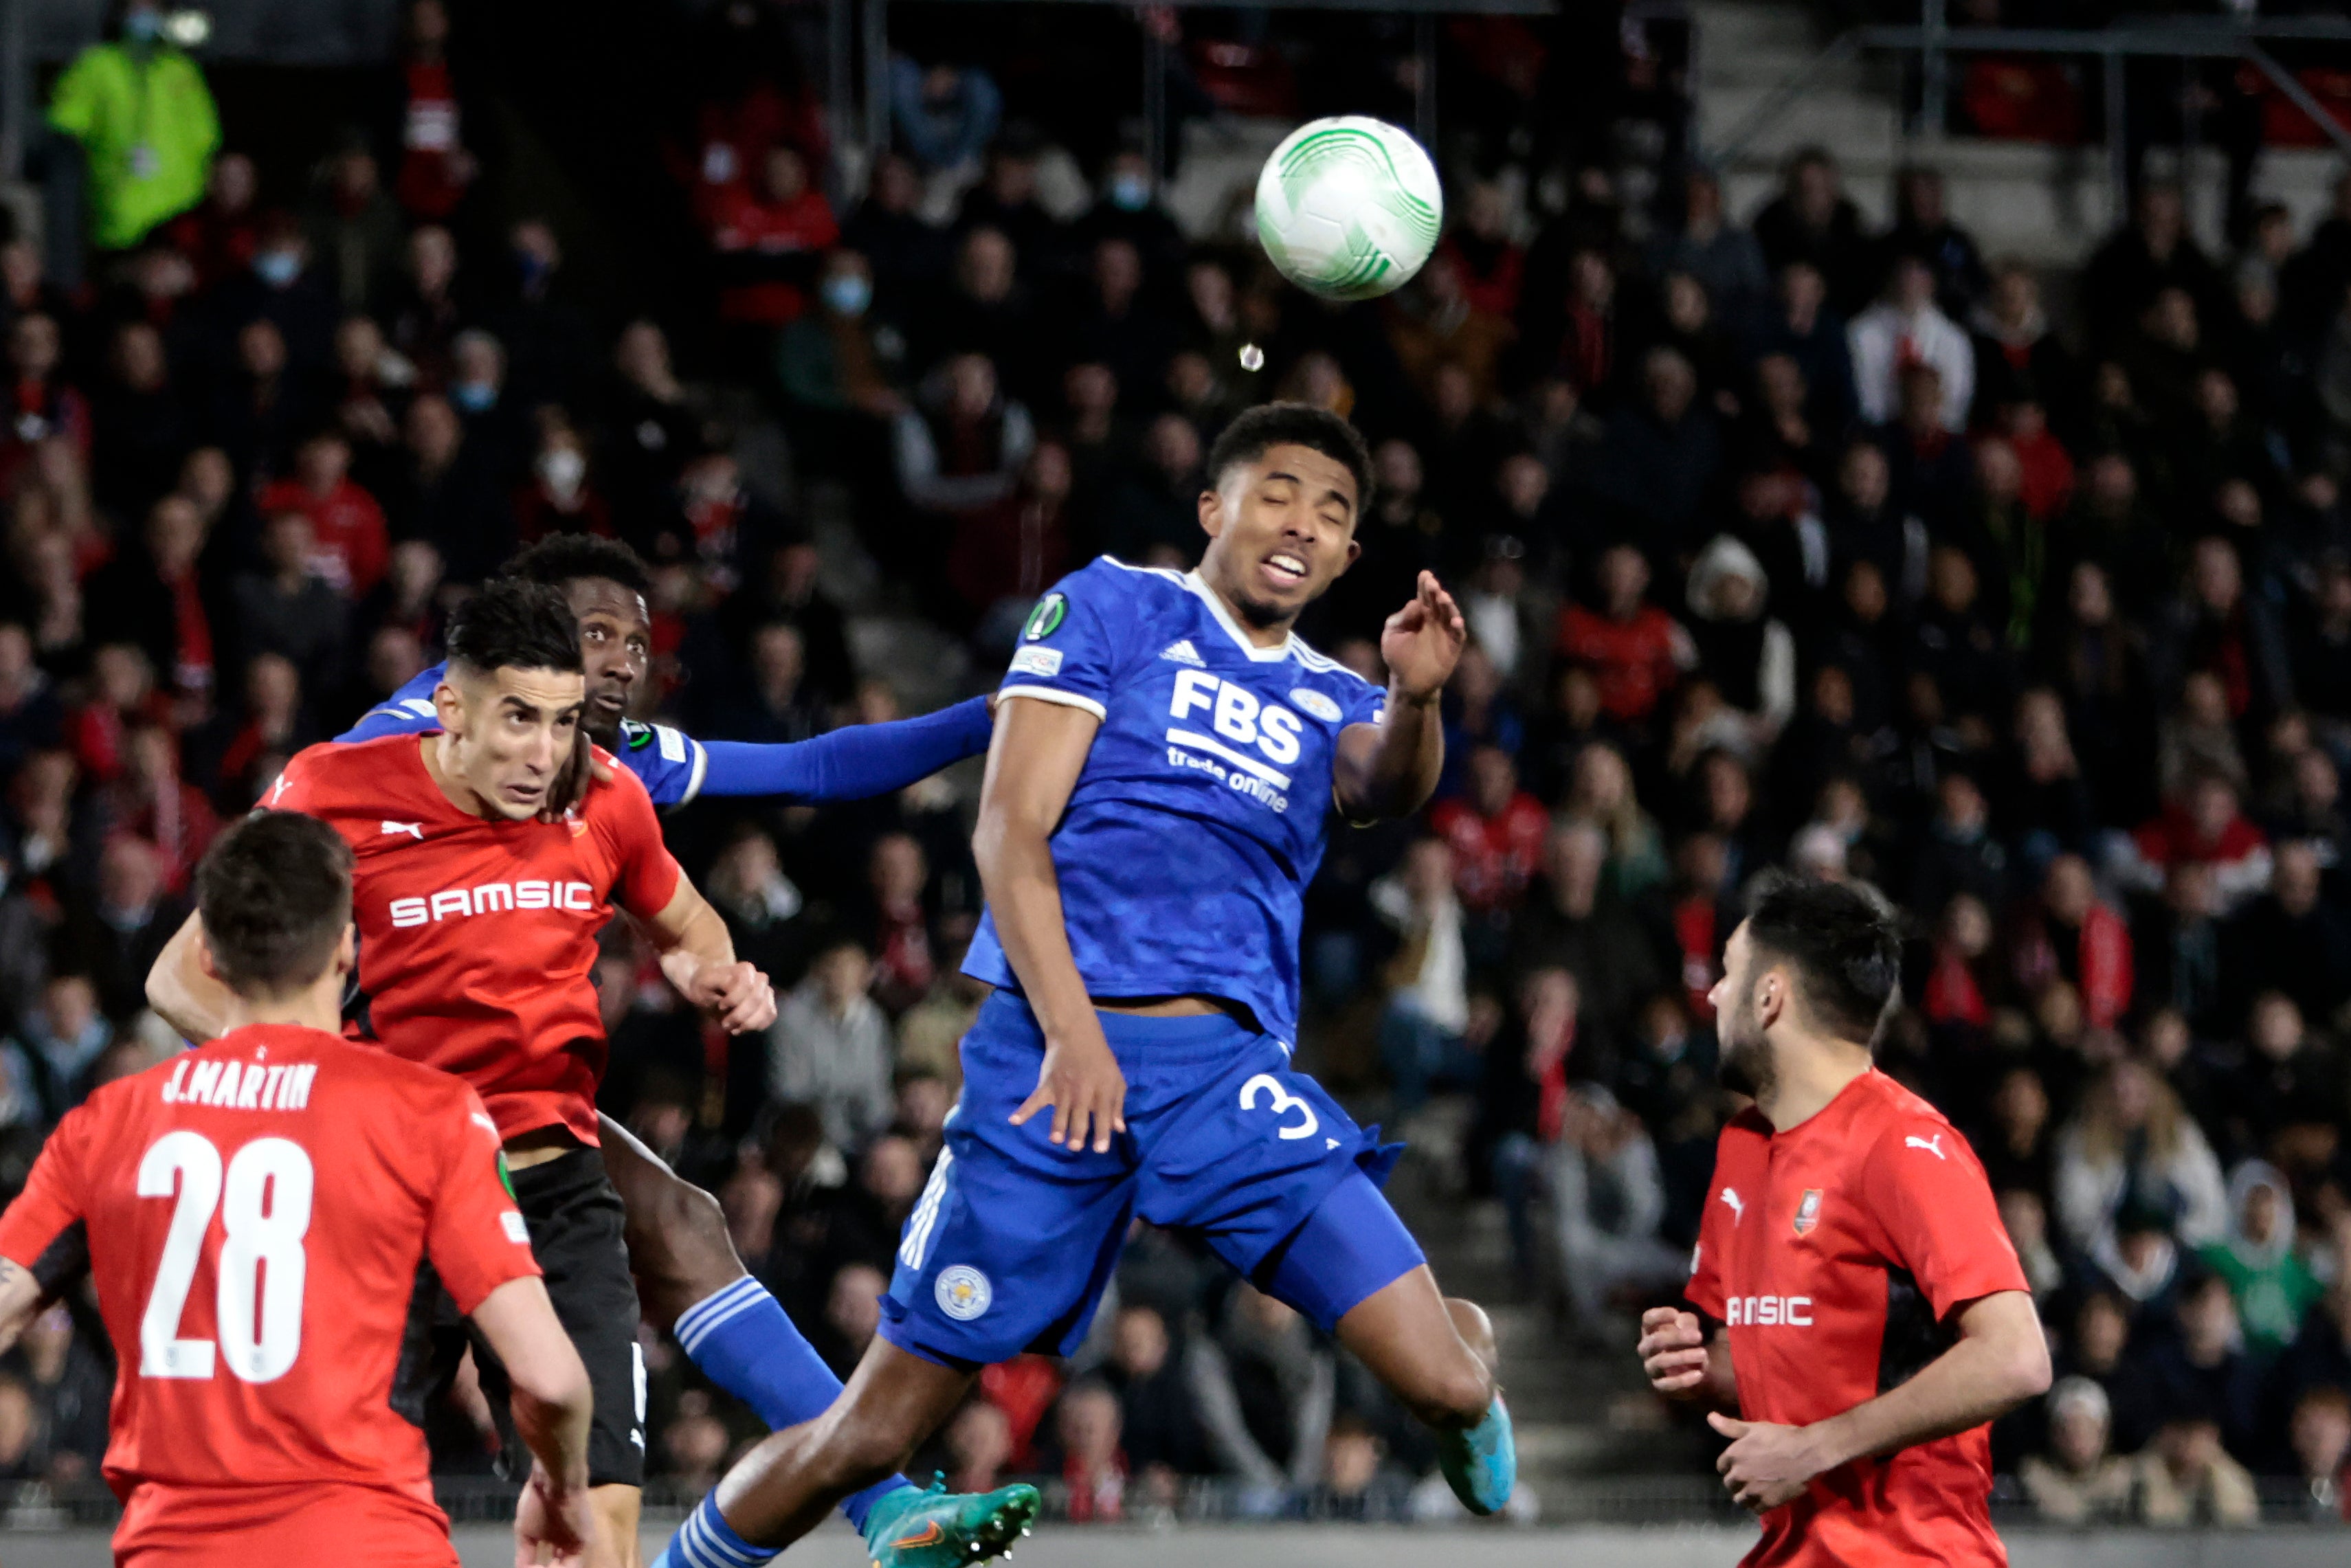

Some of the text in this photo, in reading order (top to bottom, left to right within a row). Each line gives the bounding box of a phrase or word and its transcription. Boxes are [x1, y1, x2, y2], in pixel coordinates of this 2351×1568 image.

[1169, 668, 1303, 765] FBS
[1167, 746, 1289, 814] trade online
[390, 880, 593, 928] SAMSIC
[161, 1059, 317, 1110] J.MARTIN
[1239, 1073, 1319, 1141] 3
[137, 1130, 314, 1382] 28
